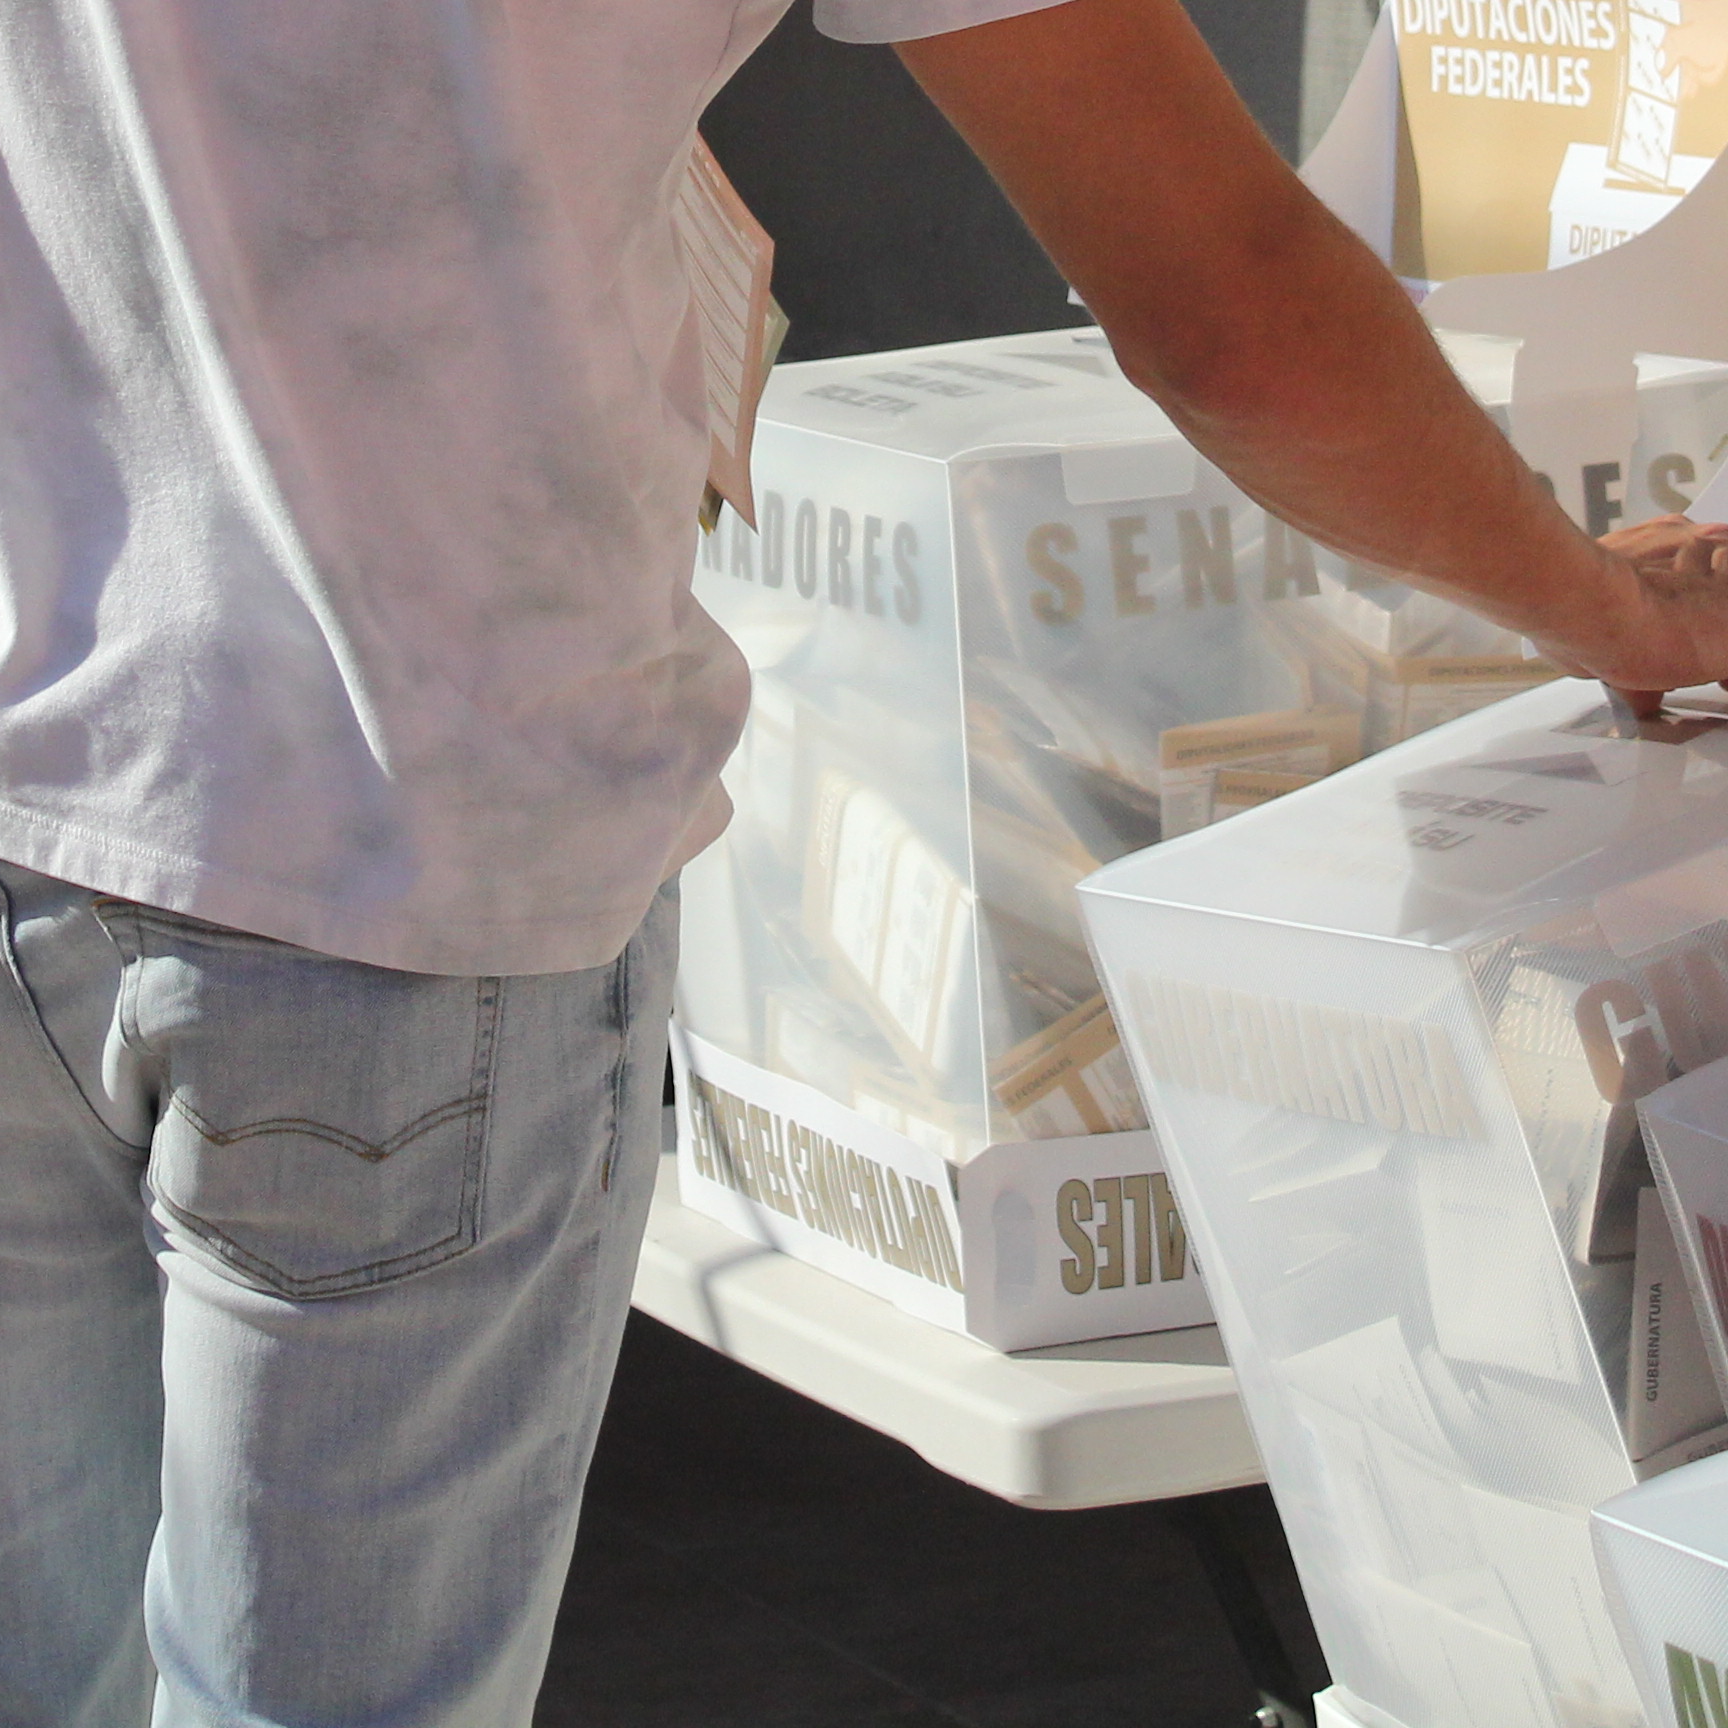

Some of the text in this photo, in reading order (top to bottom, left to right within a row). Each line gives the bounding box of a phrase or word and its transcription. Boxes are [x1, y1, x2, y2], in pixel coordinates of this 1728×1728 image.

[1430, 45, 1592, 107] FEDERALES
[702, 490, 923, 627] NADORES
[1646, 1281, 1664, 1403] GUBERNATURA
